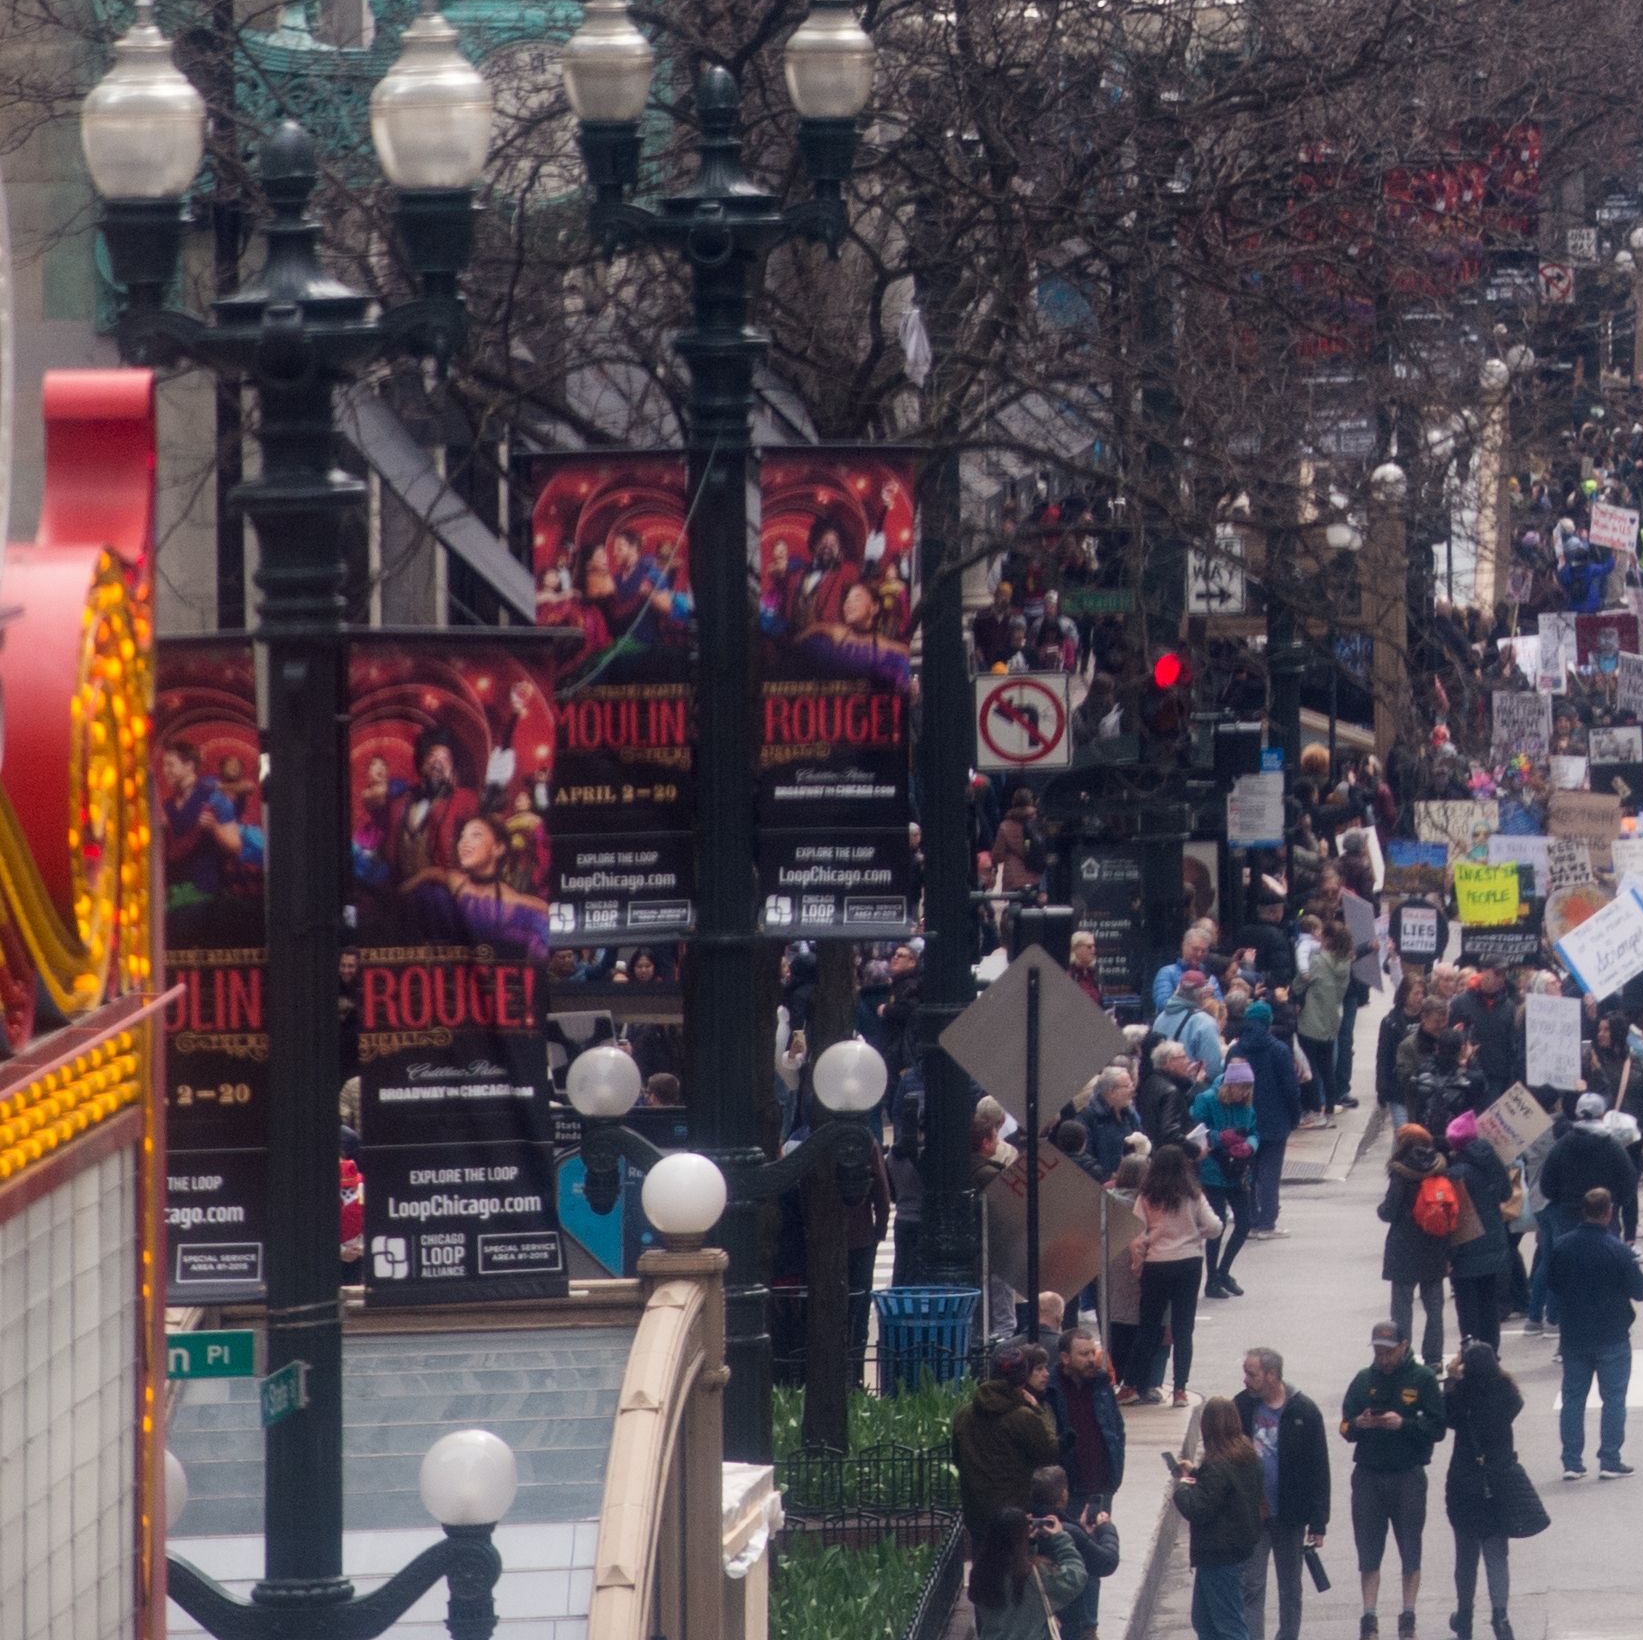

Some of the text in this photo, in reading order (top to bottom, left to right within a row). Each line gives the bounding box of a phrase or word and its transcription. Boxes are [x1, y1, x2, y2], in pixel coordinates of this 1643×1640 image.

[554, 700, 687, 749] MOULIN
[763, 695, 901, 745] ROUGE!
[555, 785, 616, 804] APRIL
[577, 851, 659, 865] EXPLORE THE LOOP
[795, 846, 876, 859] EXPLORE THE LOOP
[560, 871, 677, 892] LoopChicago.com
[778, 866, 892, 886] LoopChicago.com
[1457, 866, 1502, 881] INVEST
[1466, 889, 1512, 904] PEOPLE
[585, 909, 619, 924] LOOP
[802, 903, 836, 918] LOOP
[1402, 923, 1436, 938] LIES
[360, 964, 536, 1030] ROUGE!
[168, 1176, 223, 1191] THE LOOP
[410, 1166, 519, 1185] EXPLORE THE LOOP
[388, 1195, 542, 1222] LoopChicago.com
[420, 1233, 465, 1246] CHICAGO
[421, 1247, 465, 1266] LOOP
[421, 1264, 465, 1277] ALLIANCE
[207, 1345, 230, 1364] Pl
